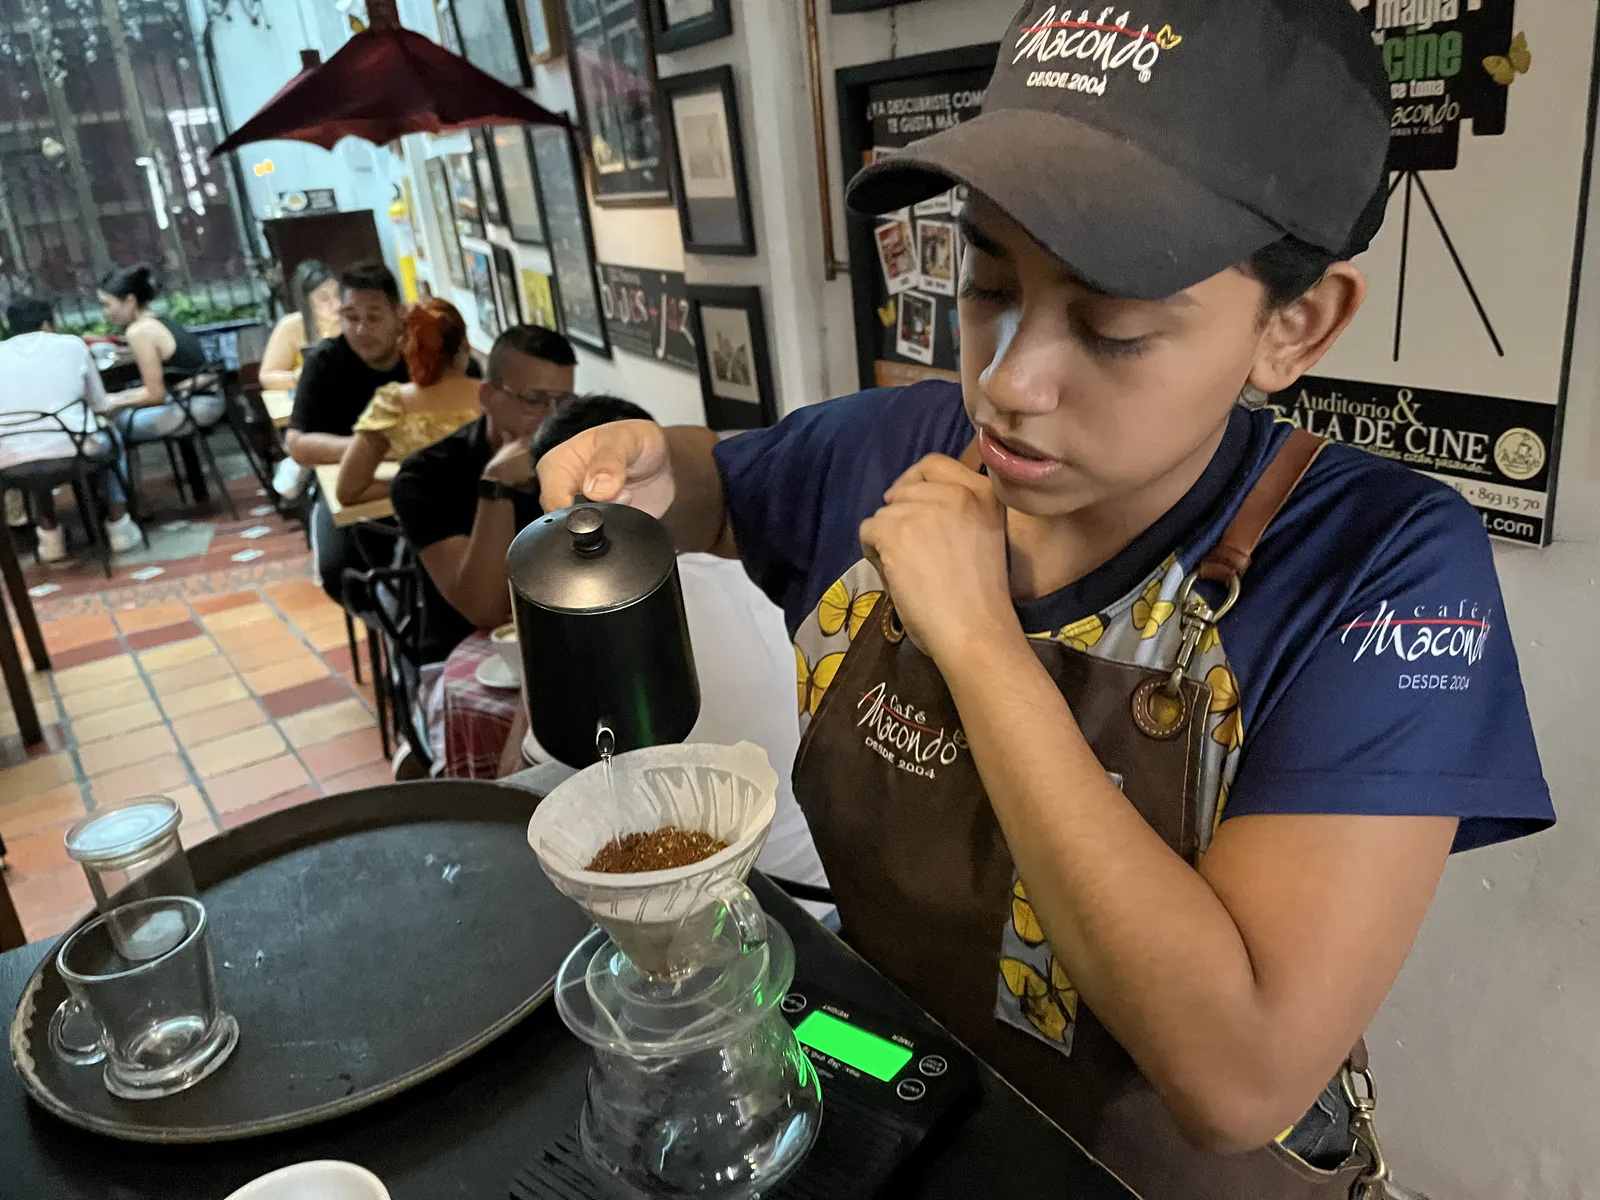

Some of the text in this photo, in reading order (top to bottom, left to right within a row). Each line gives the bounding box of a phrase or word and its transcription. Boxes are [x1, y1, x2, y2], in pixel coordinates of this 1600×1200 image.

[1012, 5, 1159, 71] Macondo
[1383, 26, 1463, 82] cine
[1026, 71, 1107, 97] DESDE 2004
[1409, 79, 1445, 98] toma
[1390, 93, 1461, 128] acondo
[1294, 388, 1423, 426] Auditorio &
[1277, 404, 1344, 442] ALA
[1353, 416, 1397, 448] DE
[1404, 423, 1490, 465] CINE
[1477, 486, 1504, 506] 893
[1413, 599, 1480, 619] café
[1398, 674, 1471, 691] DESDE 2004
[857, 681, 957, 765] Macondo
[889, 694, 926, 724] Café
[864, 736, 935, 780] DESDE 2004
